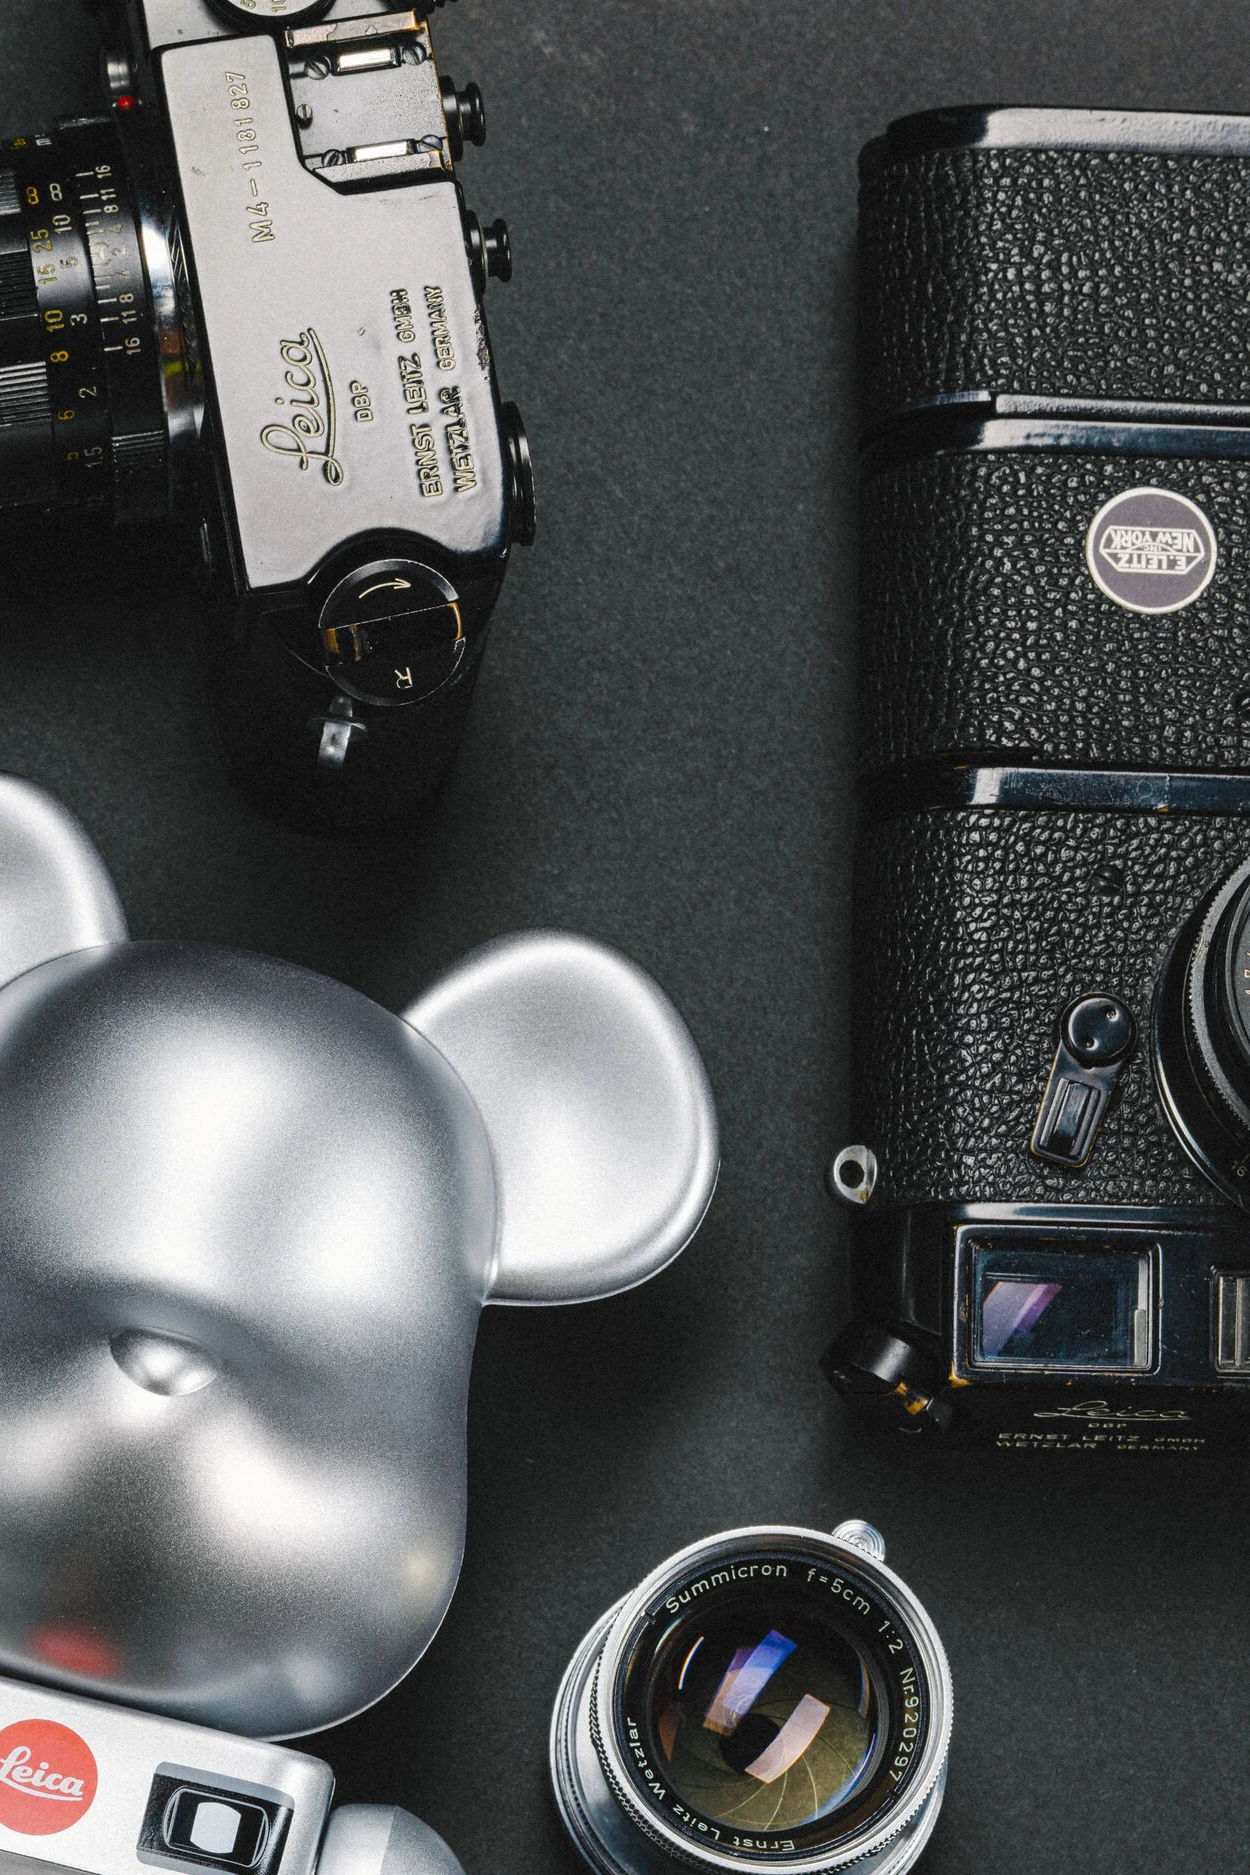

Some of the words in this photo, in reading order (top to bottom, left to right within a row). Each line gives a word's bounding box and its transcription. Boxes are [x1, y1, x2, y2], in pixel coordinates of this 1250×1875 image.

[95, 164, 112, 180] 16
[100, 188, 118, 202] 11
[103, 204, 119, 214] 8
[51, 214, 74, 235] 10
[29, 228, 54, 254] 25
[36, 262, 58, 285] 15
[59, 256, 79, 269] 5
[118, 292, 134, 304] 8
[44, 308, 66, 333] 10
[69, 312, 89, 327] 3
[121, 309, 138, 325] 11
[389, 287, 417, 344] GMBH
[423, 284, 457, 372] GERMANY
[49, 349, 70, 363] 8
[124, 336, 142, 356] 16
[78, 385, 98, 399] 2
[397, 351, 430, 416] LEITZ
[260, 327, 344, 487] Leica
[349, 379, 375, 423] DBP
[437, 384, 478, 494] WETZLAR
[409, 422, 444, 499] ERNST
[1108, 529, 1155, 551] YORK
[1155, 530, 1196, 553] NEW
[393, 666, 415, 690] R
[1033, 1400, 1192, 1421] Leica
[995, 1440, 1099, 1450] WETZLAR
[998, 1432, 1071, 1441] ERNST
[1081, 1434, 1141, 1443] LEITZ
[665, 1560, 789, 1615] Summicron
[805, 1567, 872, 1616] f=5cm
[877, 1619, 905, 1655] 1:2
[626, 1715, 667, 1799] Wetzlar
[671, 1805, 722, 1842] Leitz
[732, 1836, 796, 1852] Ernst
